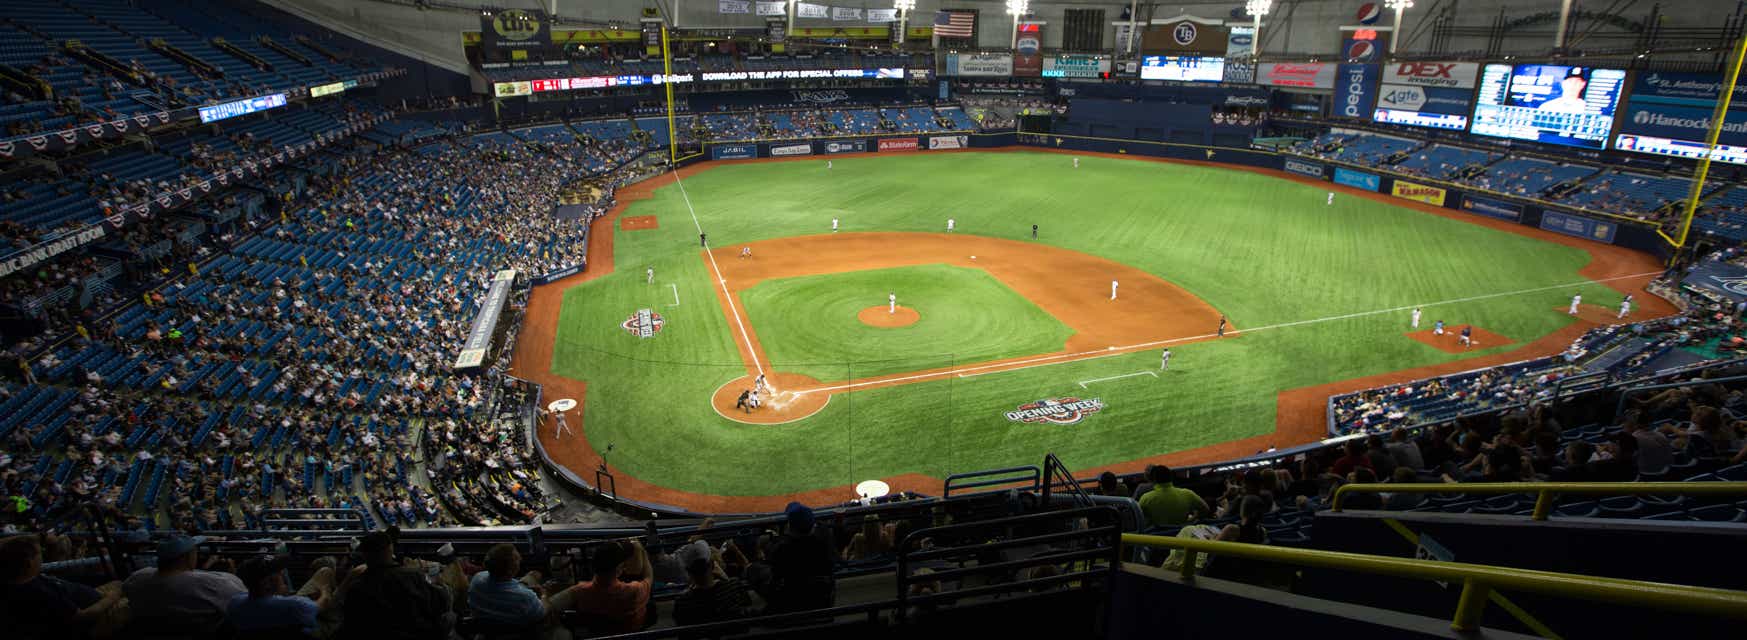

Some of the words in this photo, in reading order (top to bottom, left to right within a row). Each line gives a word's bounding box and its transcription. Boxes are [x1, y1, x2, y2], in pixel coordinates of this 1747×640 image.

[1178, 25, 1195, 42] TB
[702, 71, 748, 80] DOWNLOAD
[748, 71, 765, 79] THE
[765, 71, 782, 79] APP
[783, 70, 799, 78] FOR
[800, 70, 833, 78] SPECIAL
[833, 69, 864, 78] OFFERS
[1397, 62, 1456, 78] DEX
[1408, 75, 1458, 86] imaging
[1345, 68, 1364, 117] pepsi
[1649, 113, 1713, 129] Hancock
[1286, 160, 1322, 176] GEICO
[1006, 403, 1067, 421] OPENING
[1064, 398, 1102, 411] WEEK
